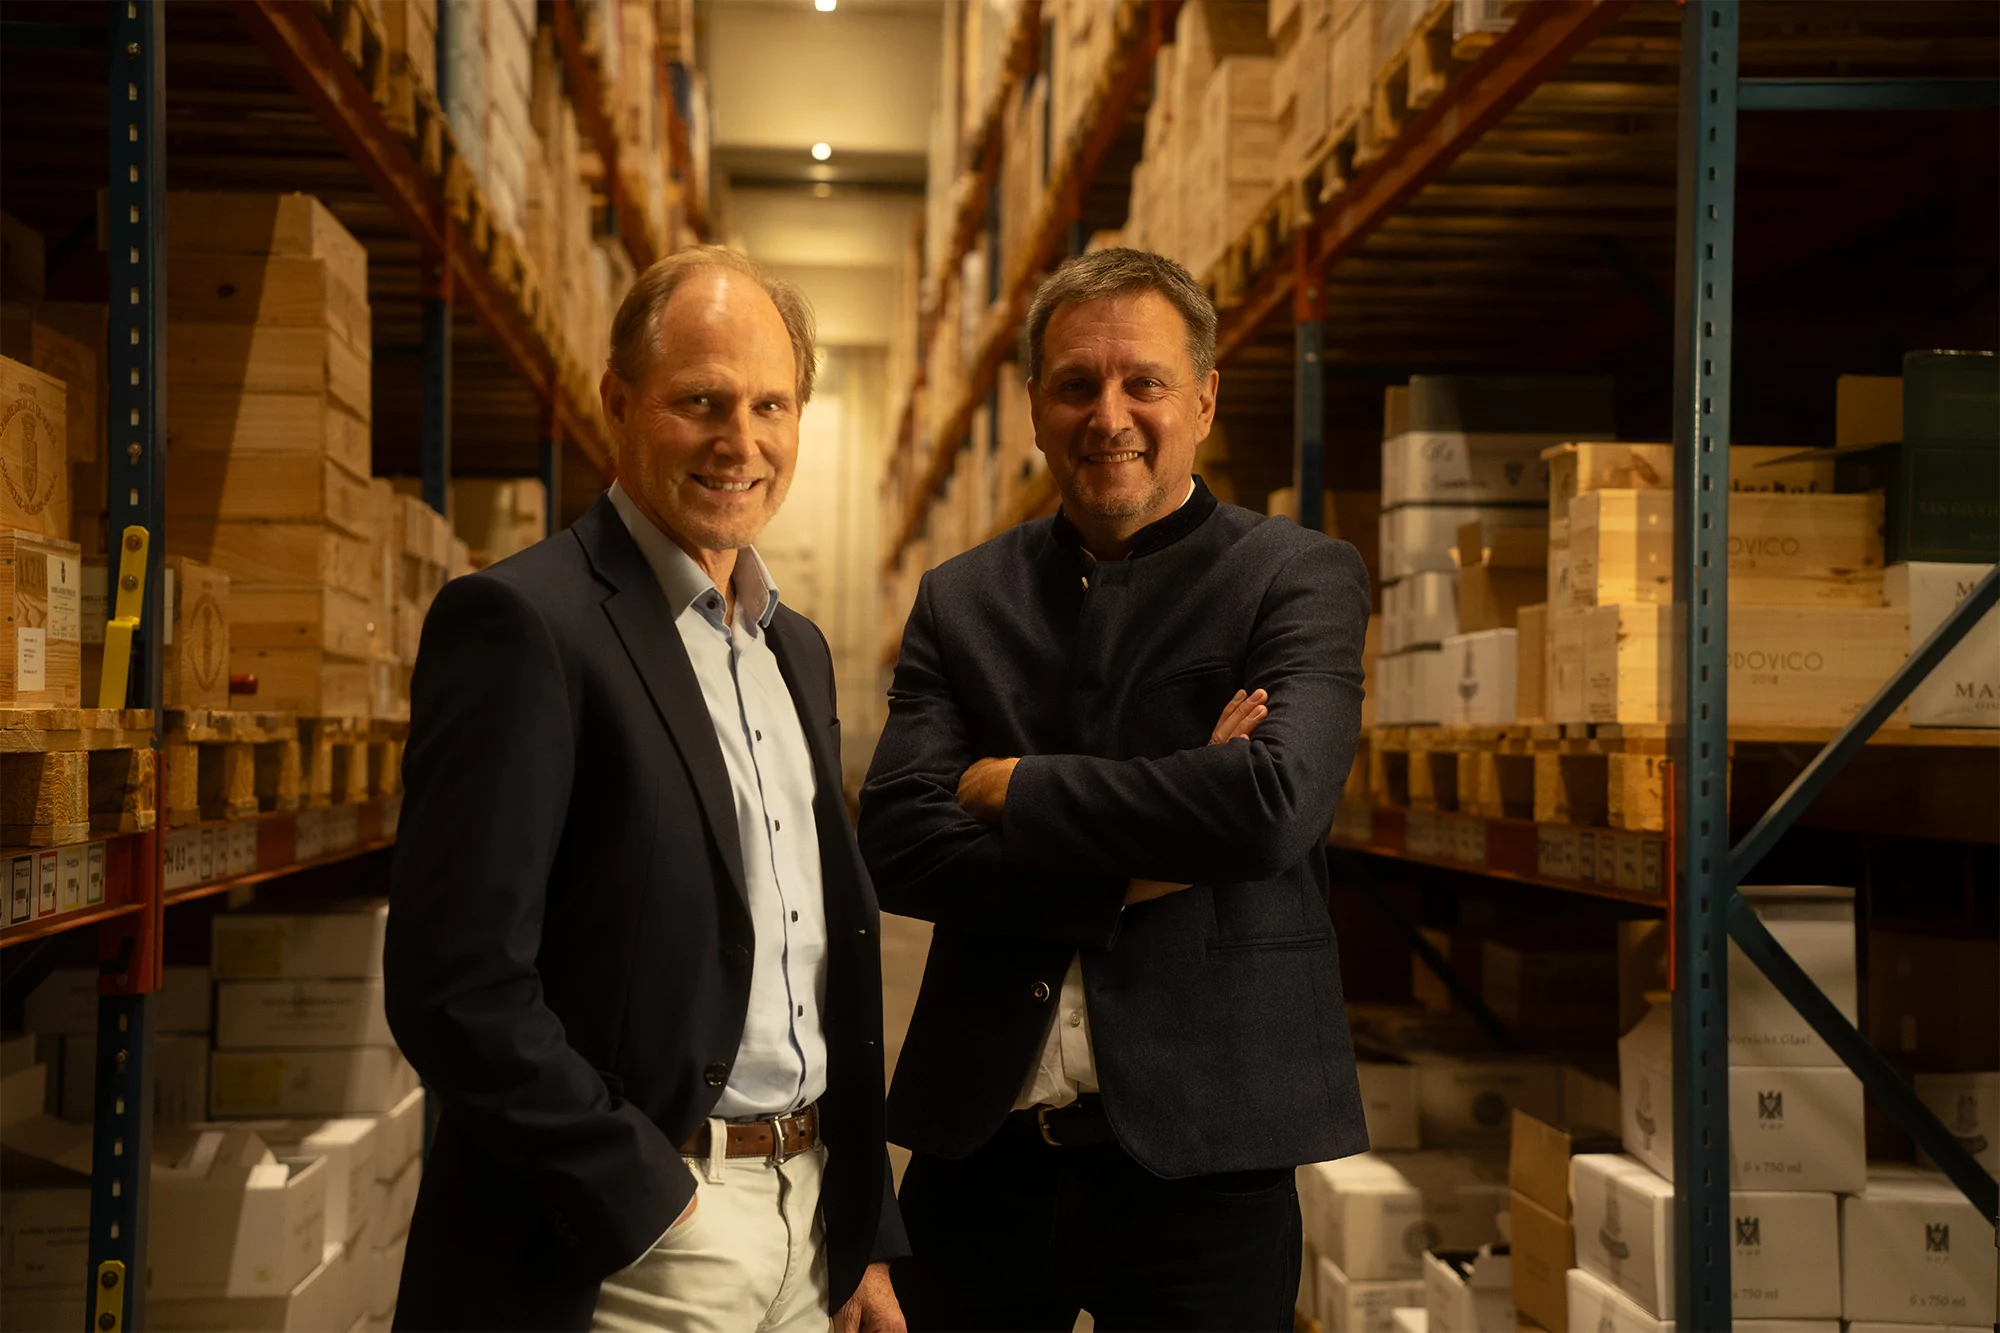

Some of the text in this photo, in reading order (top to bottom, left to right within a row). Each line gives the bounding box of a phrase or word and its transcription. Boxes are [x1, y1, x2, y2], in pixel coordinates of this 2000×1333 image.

[1729, 536, 1801, 556] OVICO
[1727, 650, 1824, 671] DOVICO
[1954, 682, 2000, 698] MA
